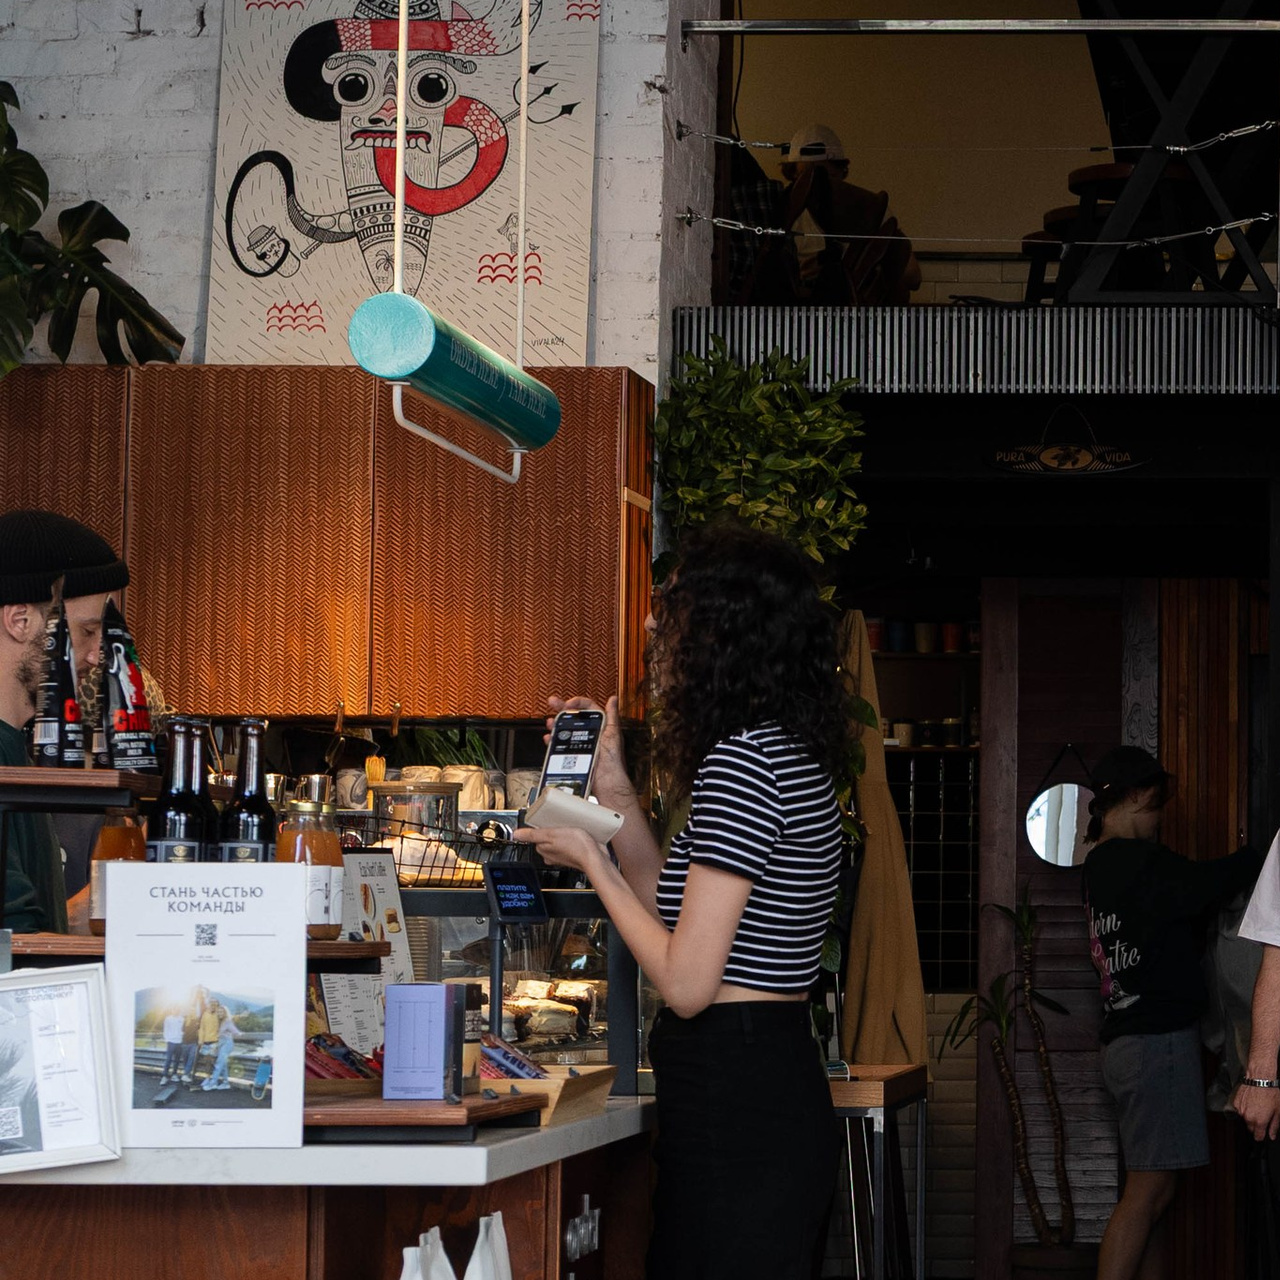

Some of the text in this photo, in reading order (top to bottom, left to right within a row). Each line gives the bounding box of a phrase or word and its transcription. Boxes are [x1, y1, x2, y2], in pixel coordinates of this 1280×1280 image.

[996, 451, 1131, 463] PURA VIDA
[149, 886, 264, 898] СТАНЬ ЧАСТЬЮ
[167, 901, 245, 913] КОМАНДЫ
